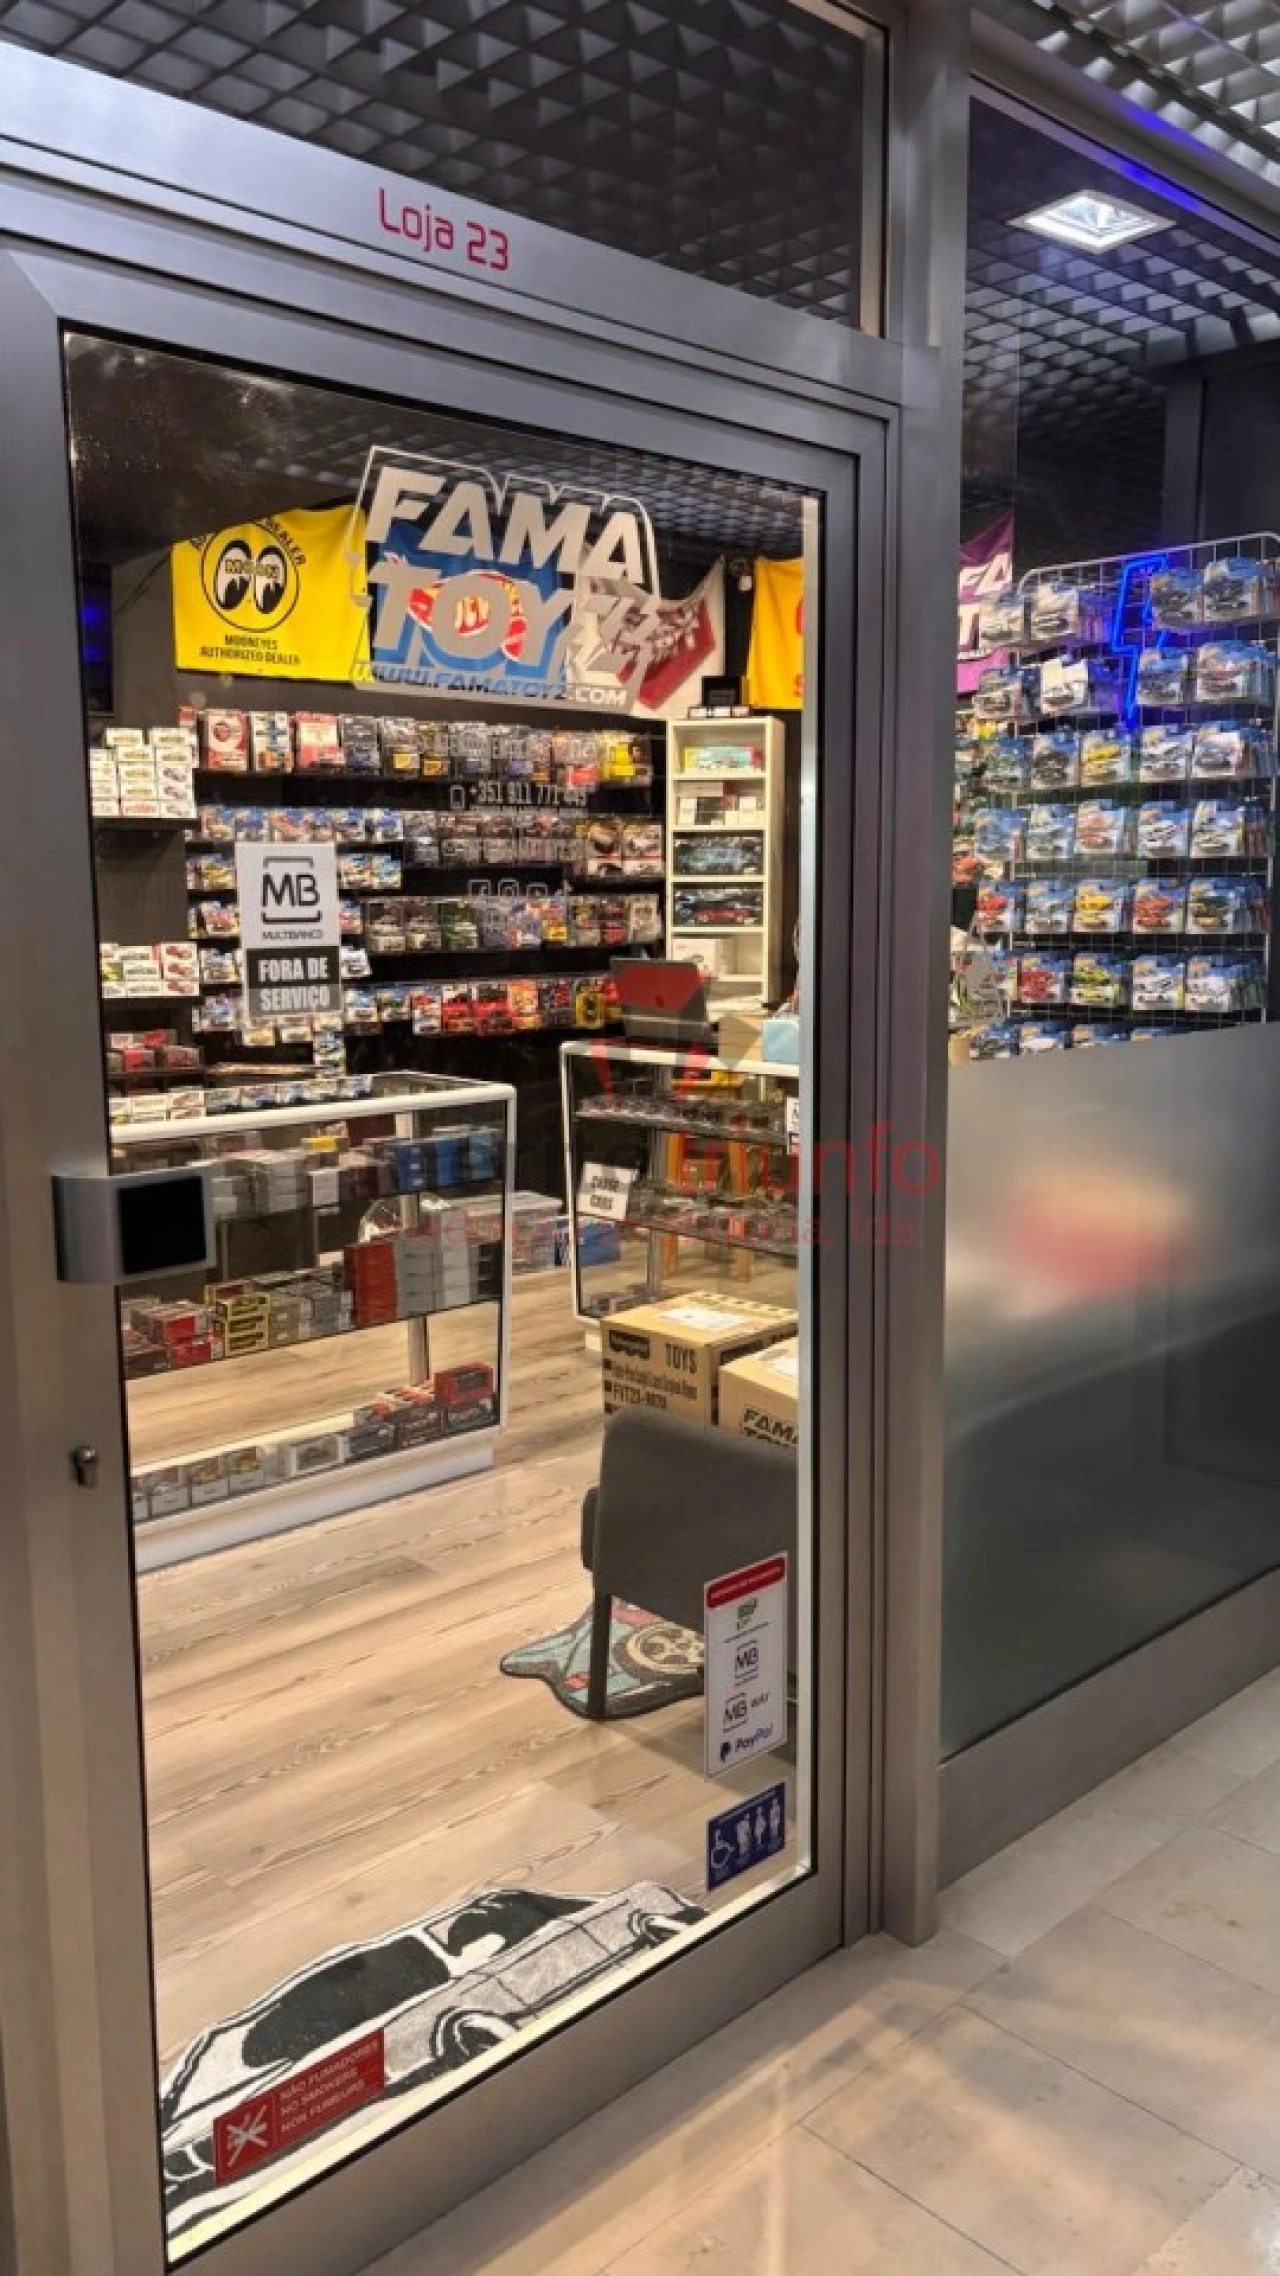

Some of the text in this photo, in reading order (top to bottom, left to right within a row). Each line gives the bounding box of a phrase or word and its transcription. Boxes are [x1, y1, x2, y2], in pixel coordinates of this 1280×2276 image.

[379, 187, 508, 270] Loja 23
[364, 466, 644, 585] FAMA
[262, 874, 320, 907] MB
[262, 929, 323, 940] MULTIBANCO
[258, 956, 329, 982] FORA DE
[260, 985, 330, 1012] SERVIÇO
[734, 1722, 774, 1753] PayPal
[281, 2066, 358, 2117] NO SMOKERS
[281, 2113, 307, 2132] NON
